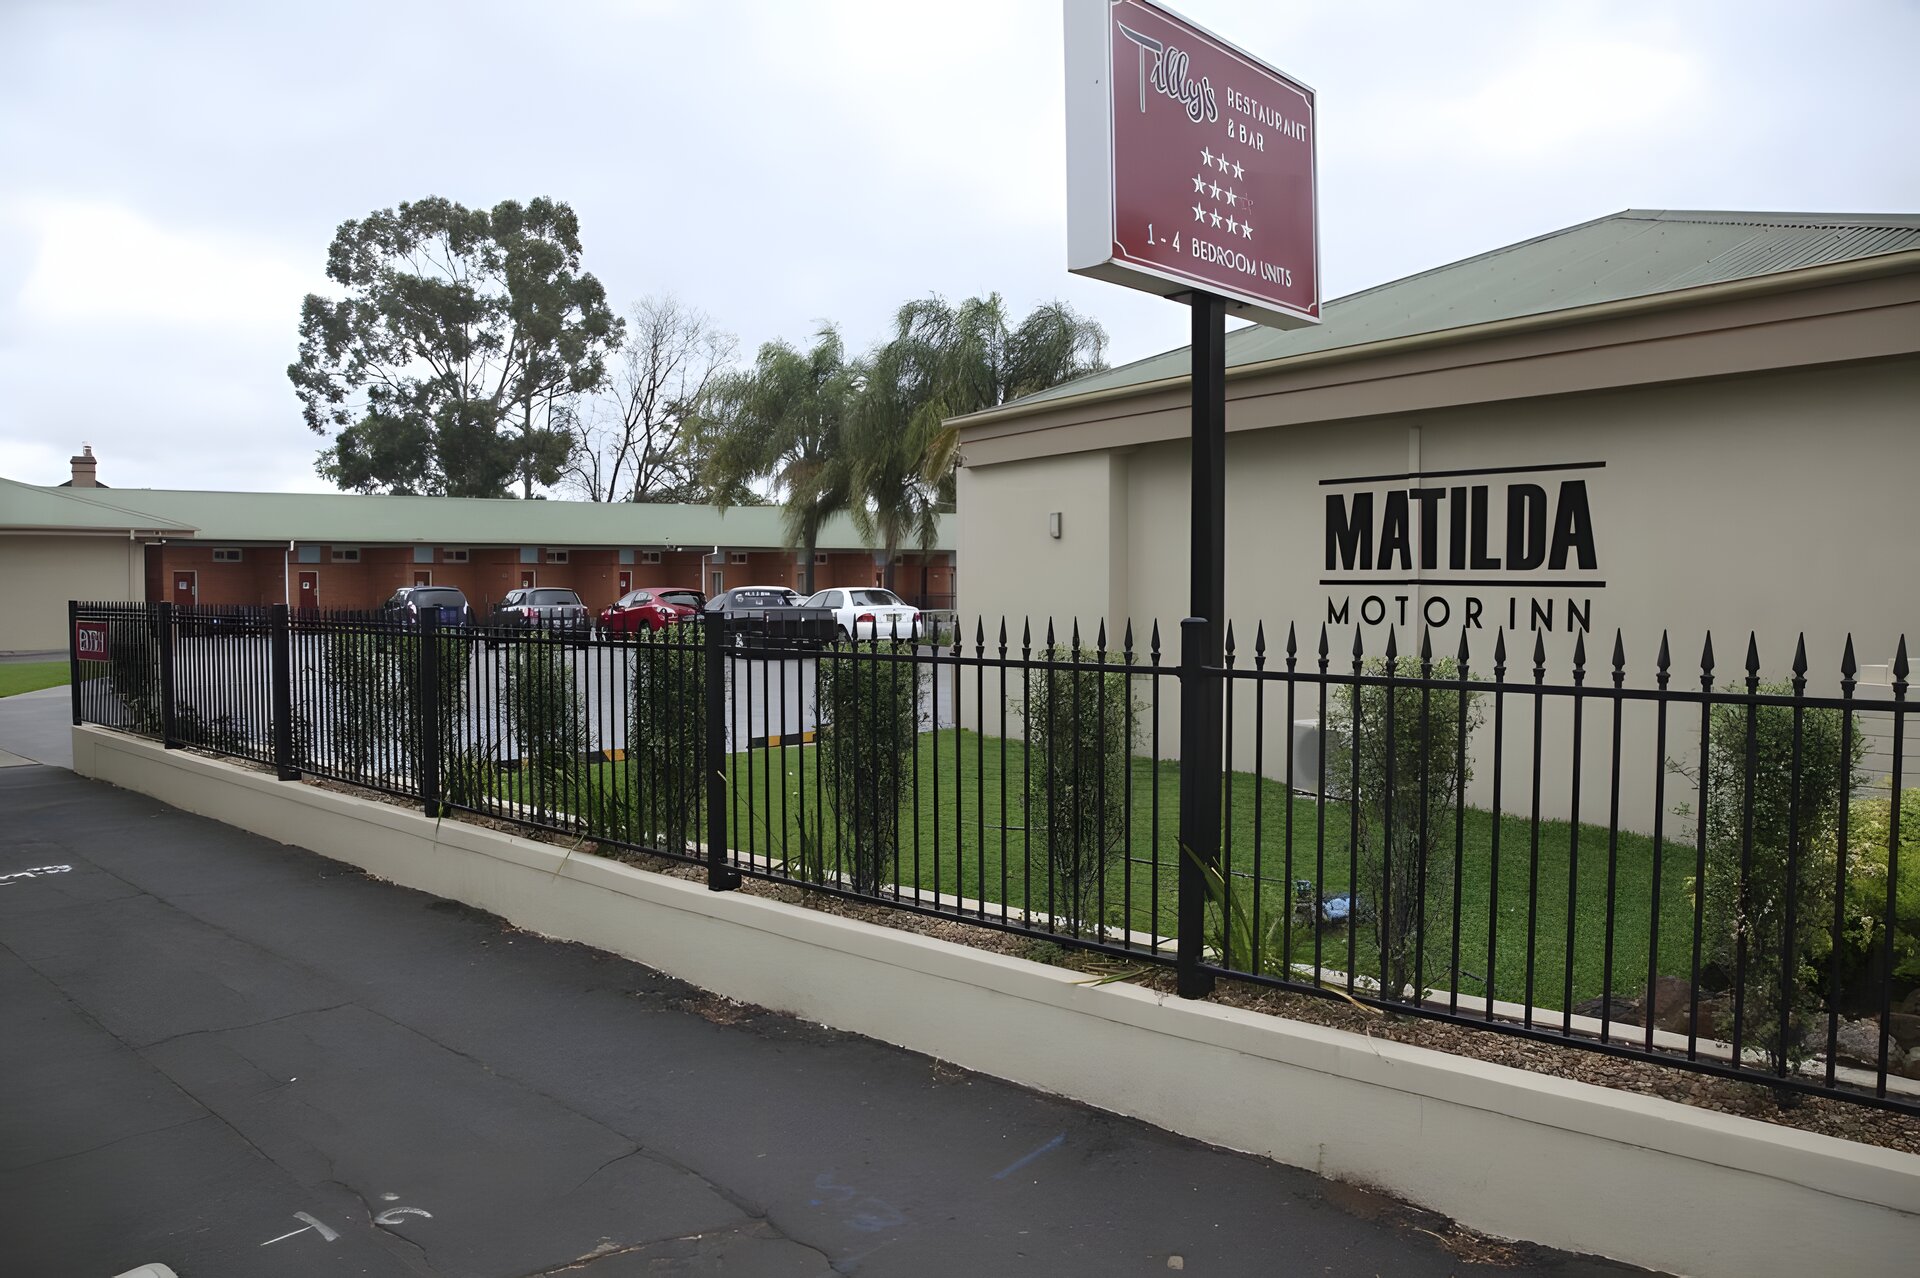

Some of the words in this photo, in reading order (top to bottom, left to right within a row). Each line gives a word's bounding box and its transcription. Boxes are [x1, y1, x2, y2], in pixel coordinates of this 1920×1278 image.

[1117, 20, 1218, 123] Tilly's
[1227, 86, 1306, 142] RESTAURANT
[1227, 118, 1235, 138] &
[1239, 123, 1264, 152] BAR
[1147, 223, 1155, 245] 1
[1172, 231, 1180, 253] 4
[1192, 237, 1257, 276] BEDROOM
[1260, 260, 1292, 288] UNITS
[1325, 480, 1597, 571] MATILDA
[1327, 595, 1483, 629] MOTOR
[1509, 597, 1591, 633] INN
